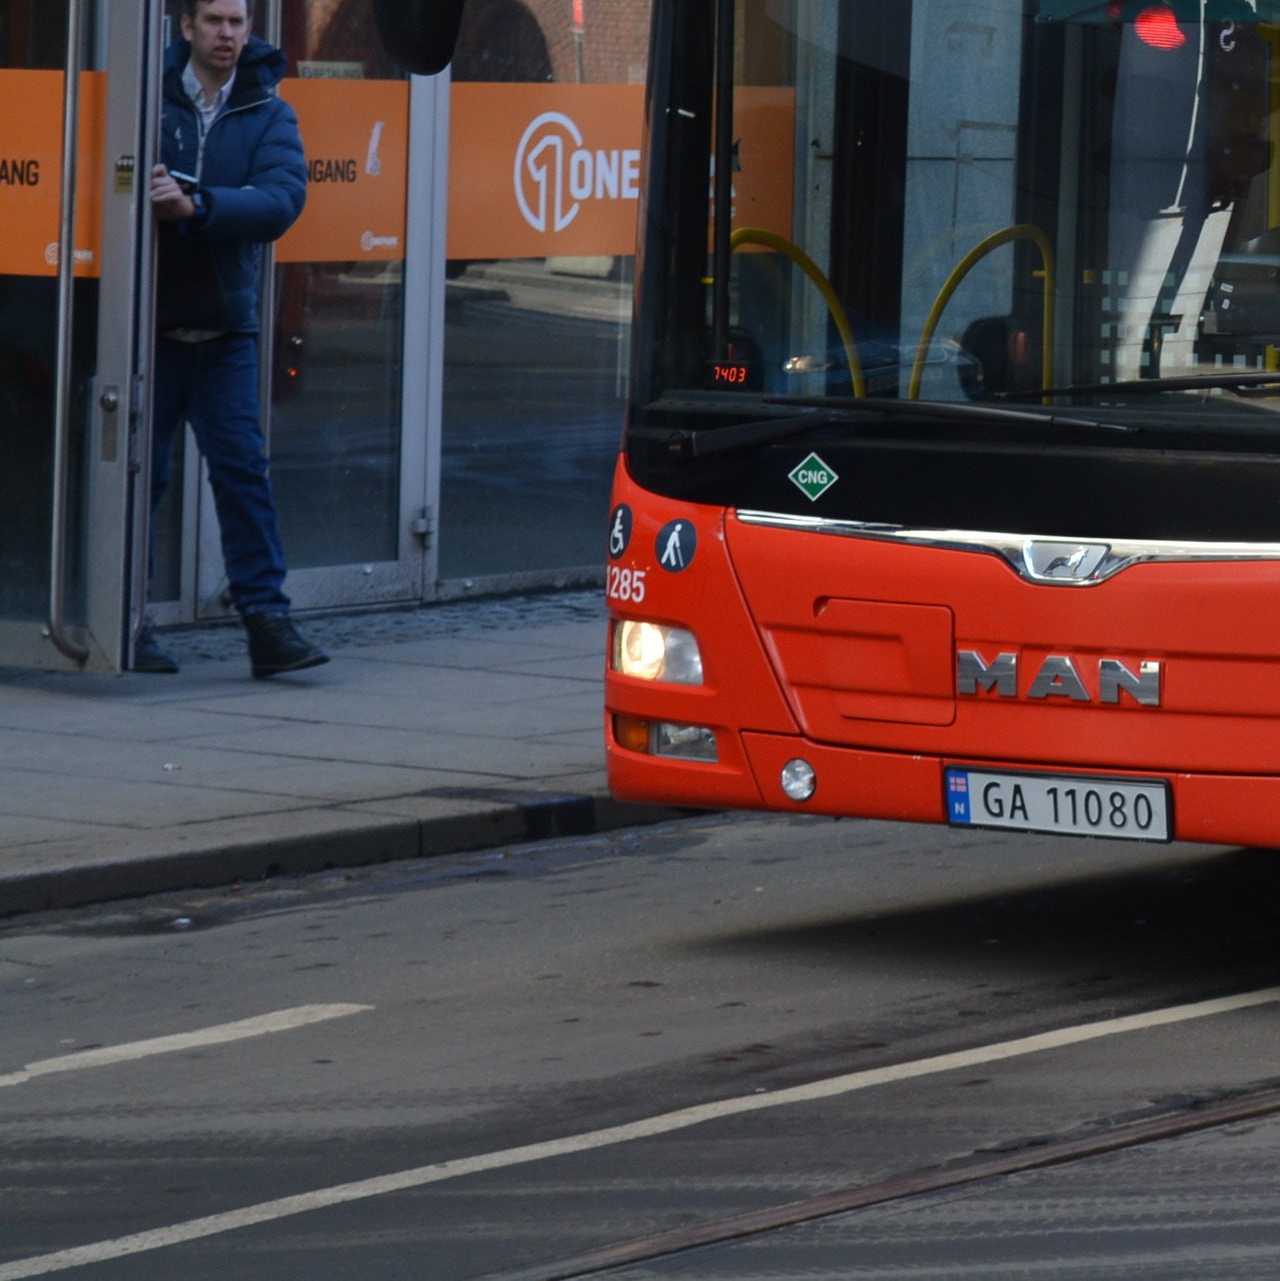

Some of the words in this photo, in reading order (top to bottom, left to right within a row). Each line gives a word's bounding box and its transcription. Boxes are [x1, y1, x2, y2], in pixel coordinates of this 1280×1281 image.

[714, 366, 746, 382] 7403
[798, 469, 828, 484] CNG
[957, 649, 1161, 706] MAN
[954, 802, 965, 814] N
[982, 781, 1029, 821] GA
[1046, 786, 1153, 830] 11080
